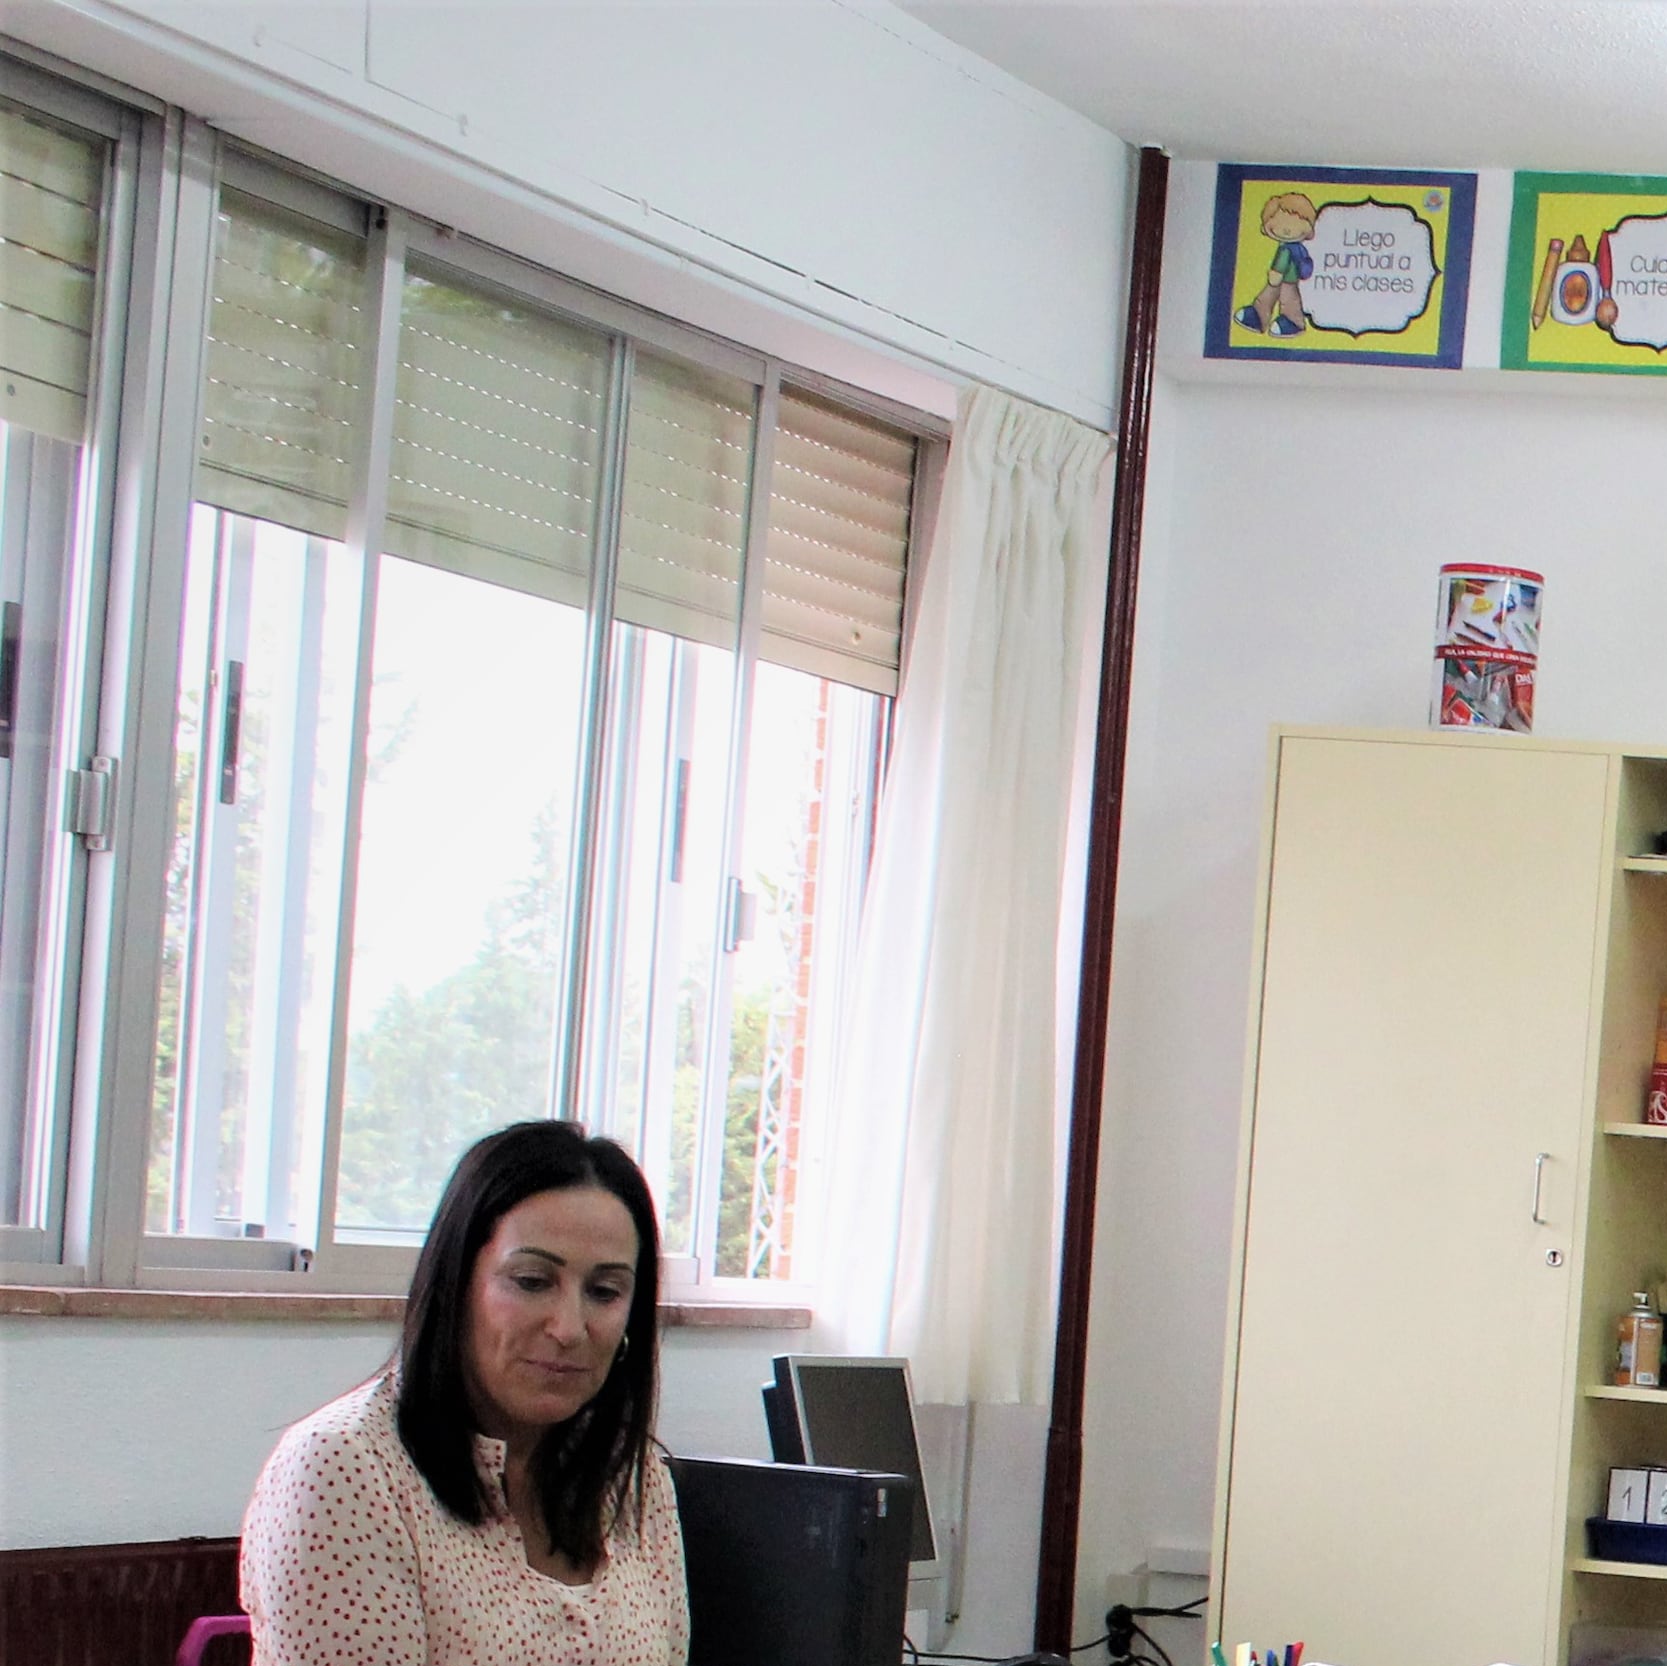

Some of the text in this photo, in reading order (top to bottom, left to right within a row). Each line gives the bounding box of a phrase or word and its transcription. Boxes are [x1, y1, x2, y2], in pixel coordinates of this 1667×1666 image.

[1342, 228, 1396, 252] Llego
[1323, 251, 1411, 272] puntual a
[1313, 273, 1348, 291] mis
[1621, 1485, 1633, 1512] 1
